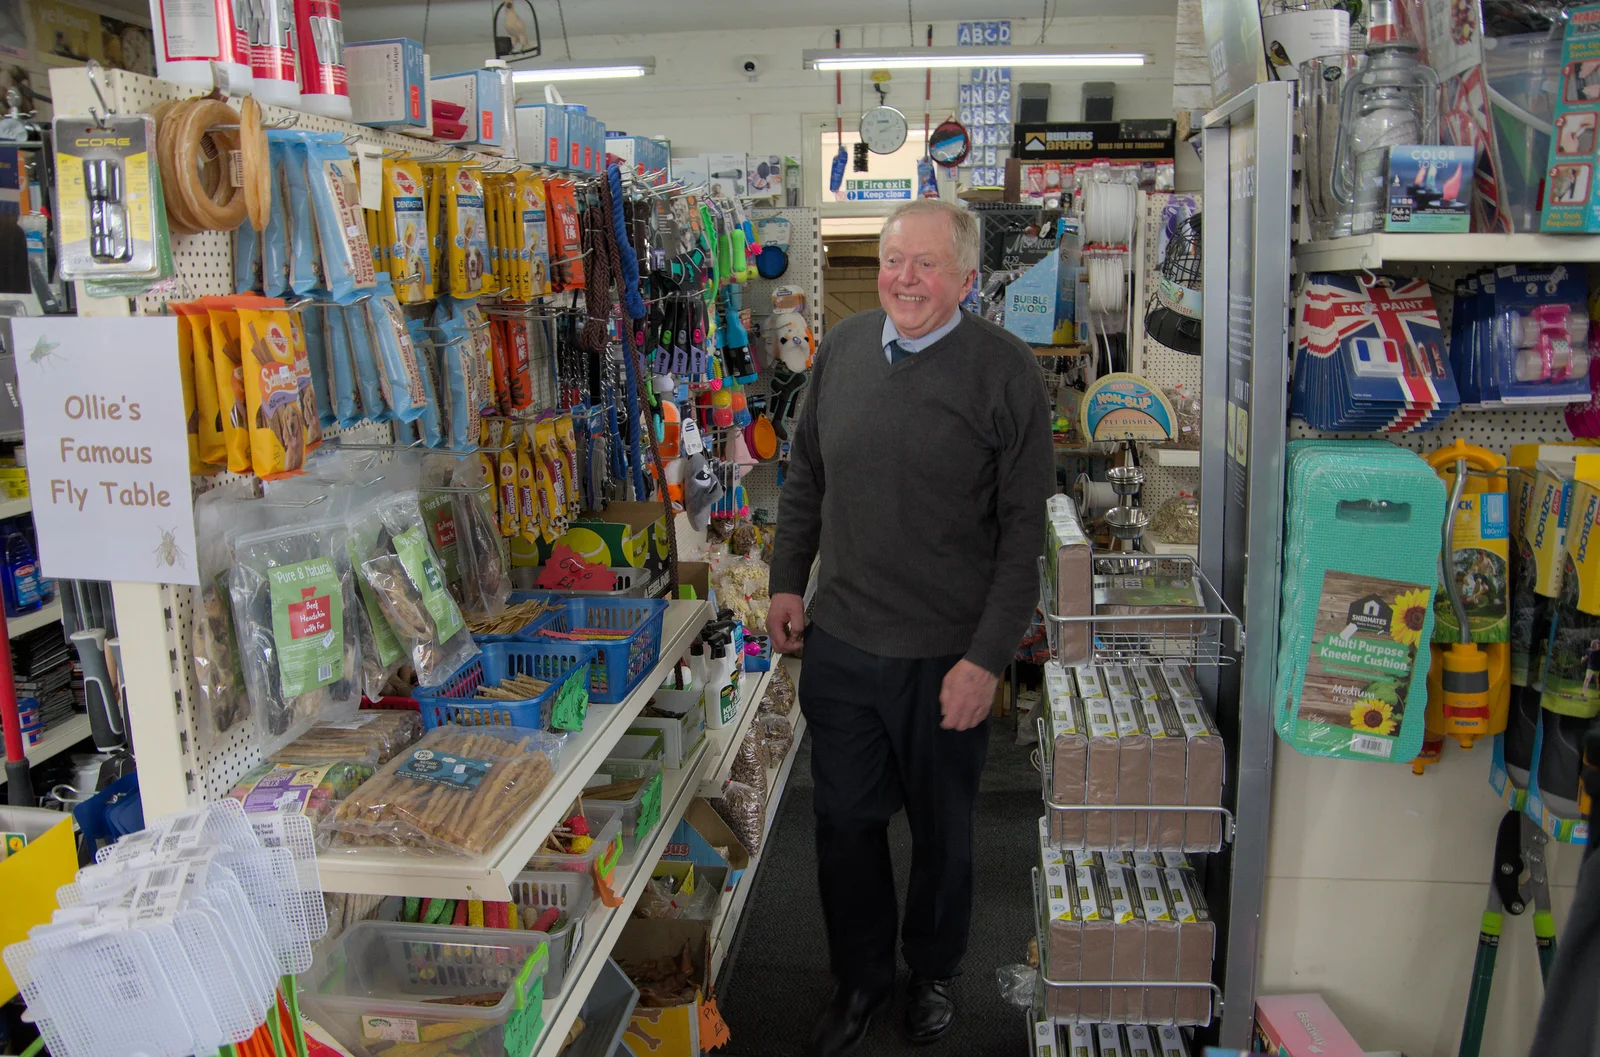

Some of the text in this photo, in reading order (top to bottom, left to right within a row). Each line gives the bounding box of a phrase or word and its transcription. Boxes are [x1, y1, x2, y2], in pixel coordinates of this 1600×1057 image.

[75, 137, 131, 148] CORE
[1046, 131, 1094, 141] BUILDERS
[1046, 141, 1094, 151] BRAND
[1411, 149, 1456, 161] COLOR
[863, 180, 906, 189] Fire exit
[863, 190, 905, 200] Keep clear
[1512, 275, 1527, 283] TAPE
[1013, 294, 1048, 305] BUBBLE
[1381, 300, 1423, 312] PAINT
[1013, 303, 1048, 314] SWORD
[64, 395, 141, 421] Ollie's
[1096, 392, 1152, 409] NON-SLIP
[60, 437, 153, 464] Famous
[50, 479, 172, 512] Fly Table
[507, 484, 516, 514] Jumbone
[523, 487, 533, 516] Jumbone
[1534, 484, 1554, 550] HOZELOCK
[1576, 494, 1598, 565] HOZELOCK
[276, 561, 332, 583] Pure & Natural
[305, 600, 319, 610] Beef
[1351, 614, 1387, 626] SHEDMATES
[1329, 635, 1404, 658] Multi Purpose
[1320, 646, 1408, 671] Kneeler Cushion
[1331, 684, 1375, 700] Medium
[1297, 1011, 1326, 1046] Bestway
